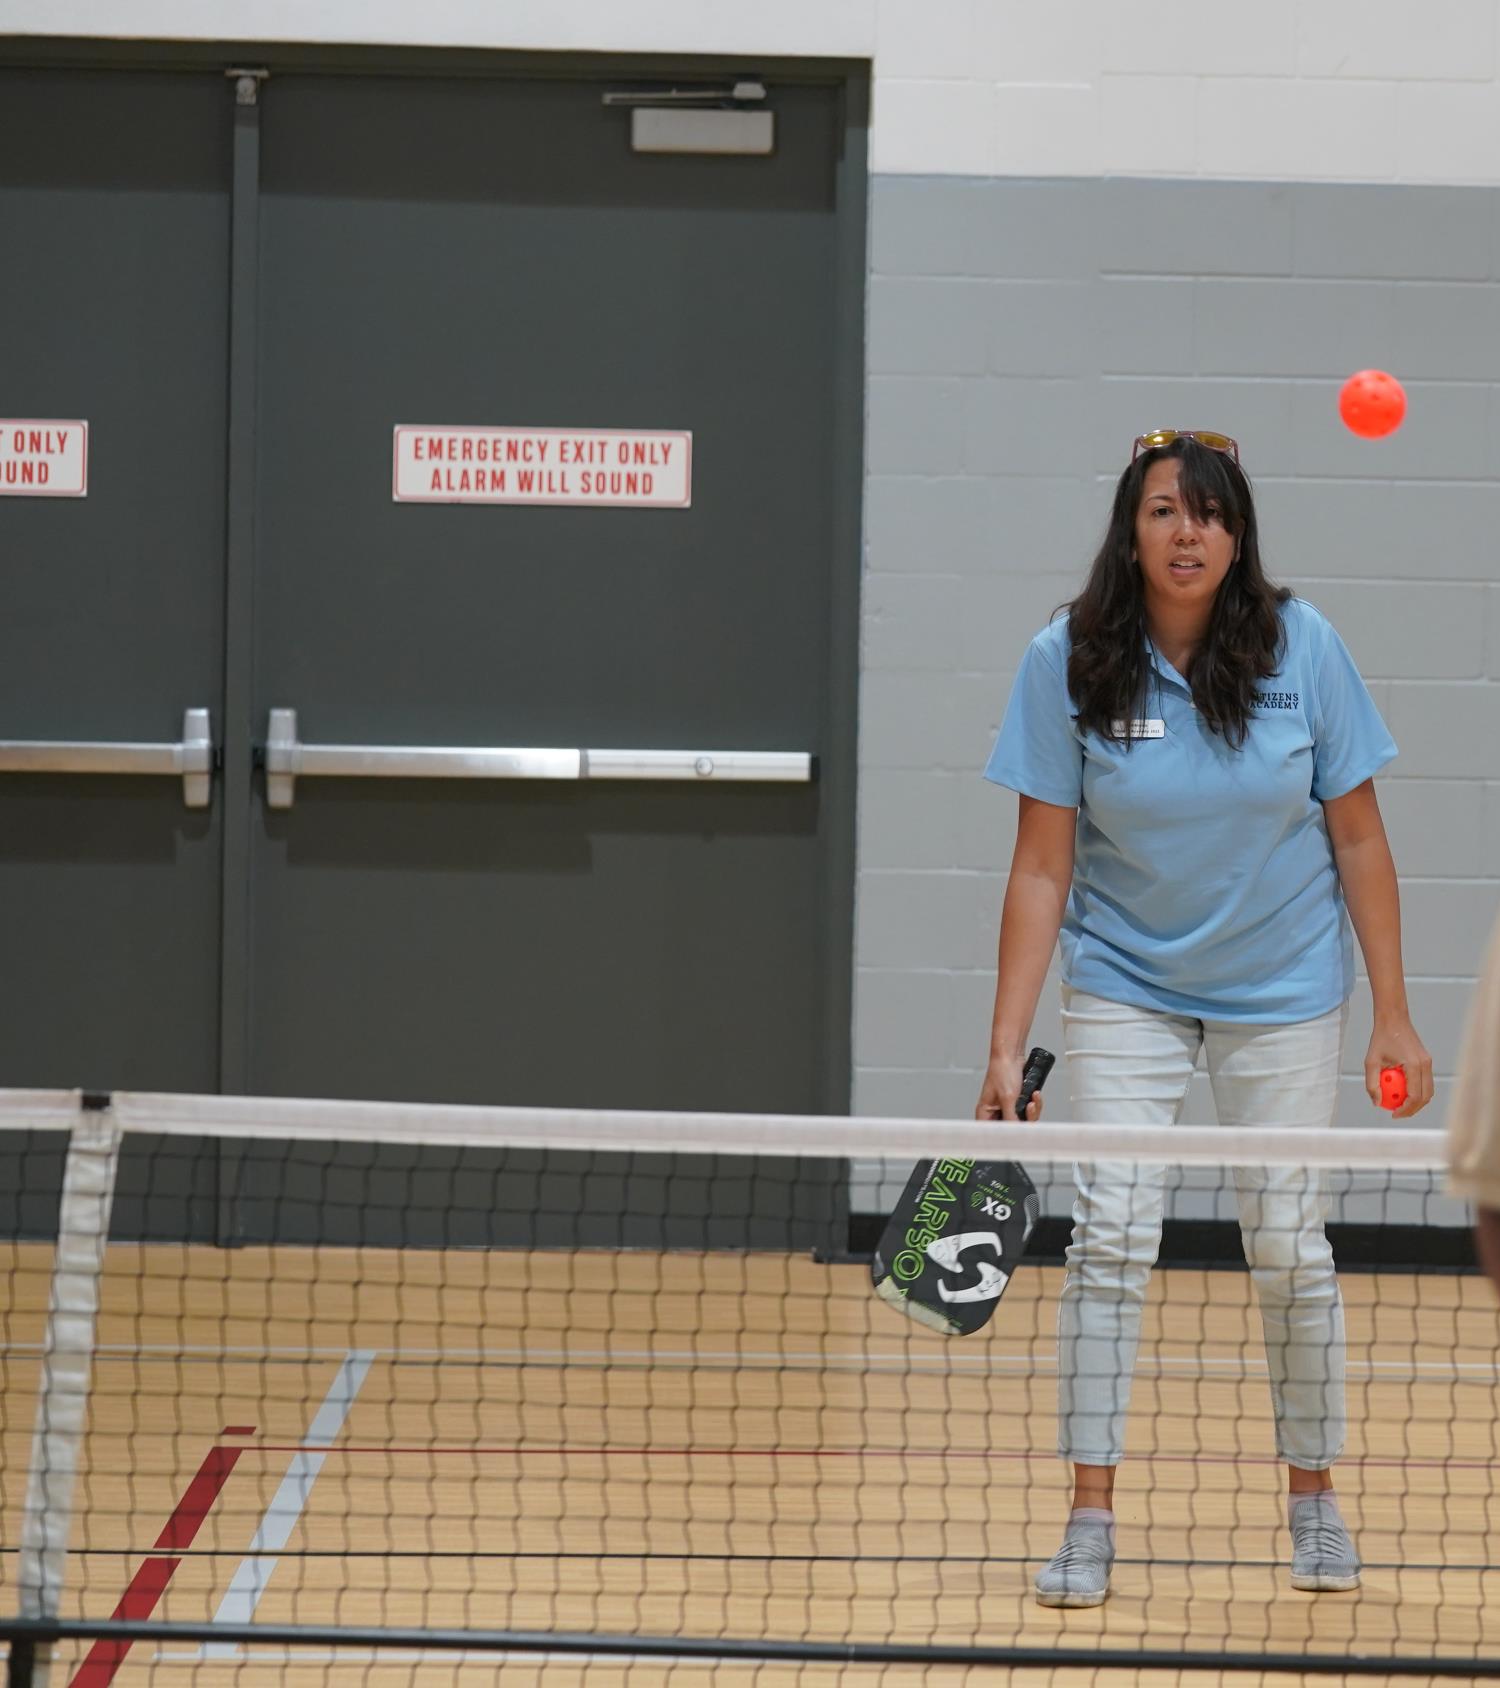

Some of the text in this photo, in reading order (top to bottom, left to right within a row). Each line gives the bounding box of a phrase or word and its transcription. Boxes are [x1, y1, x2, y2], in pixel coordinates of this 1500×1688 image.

[13, 429, 68, 454] ONLY
[413, 437, 673, 465] EMERGENCY EXIT ONLY
[0, 460, 49, 485] UND
[430, 468, 653, 496] ALARM WILL SOUND
[1250, 701, 1299, 710] ACADEMY
[1255, 692, 1299, 702] TIZENS
[887, 1156, 977, 1297] EARBO
